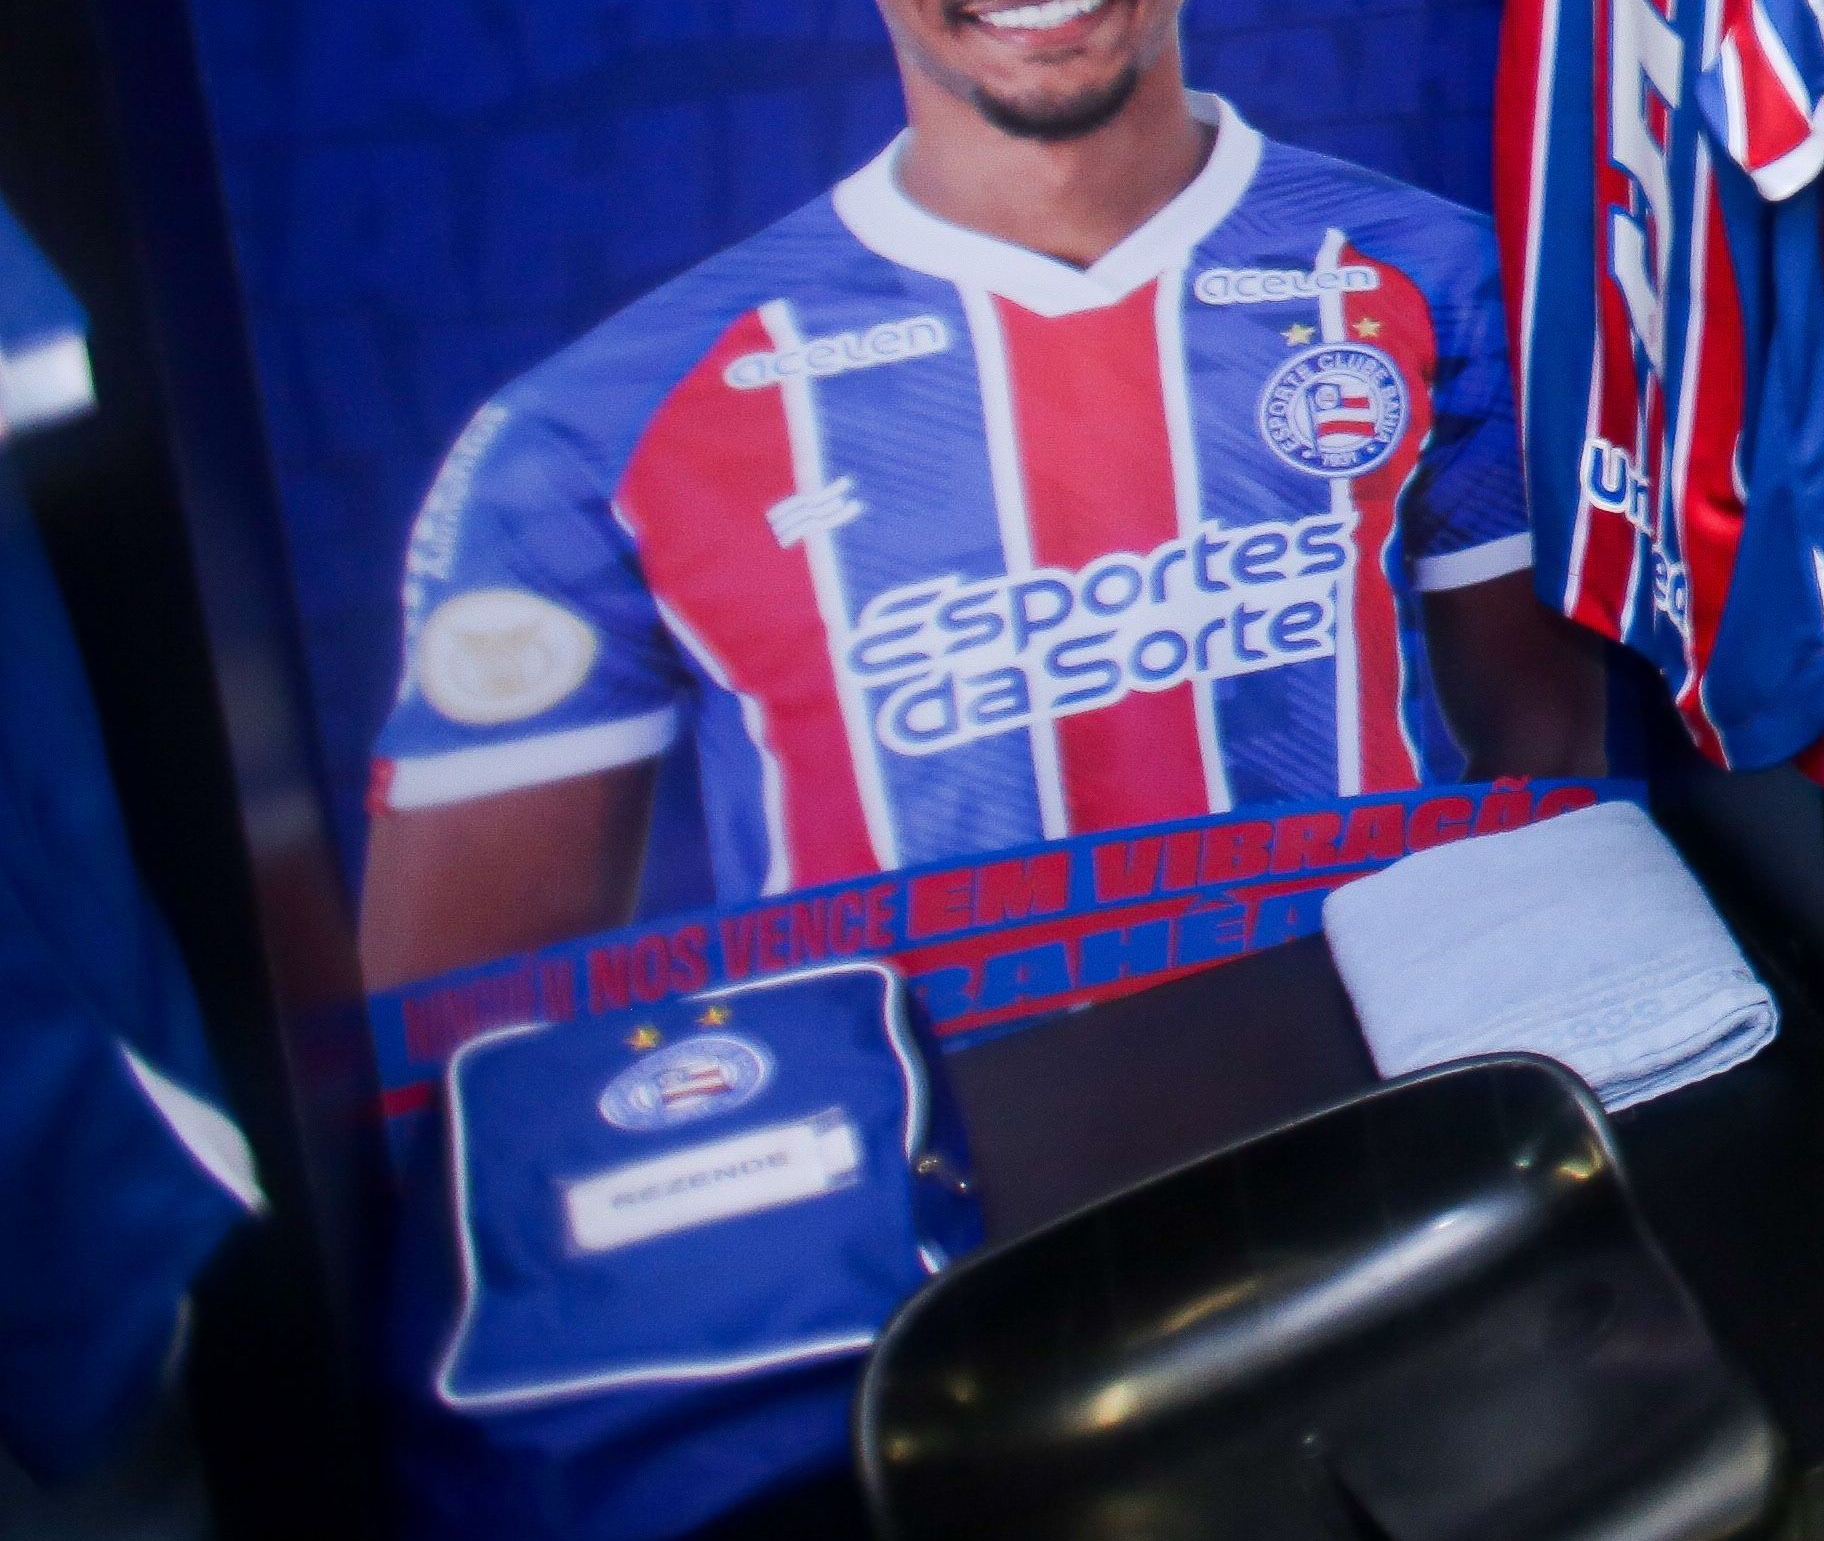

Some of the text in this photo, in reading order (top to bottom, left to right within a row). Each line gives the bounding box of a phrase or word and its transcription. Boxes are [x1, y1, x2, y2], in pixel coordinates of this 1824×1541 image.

[1196, 264, 1379, 306] acelen
[849, 511, 1354, 675] Esportes
[588, 924, 709, 1016] NOS
[719, 882, 896, 980] VENCE
[905, 851, 1071, 941] EM
